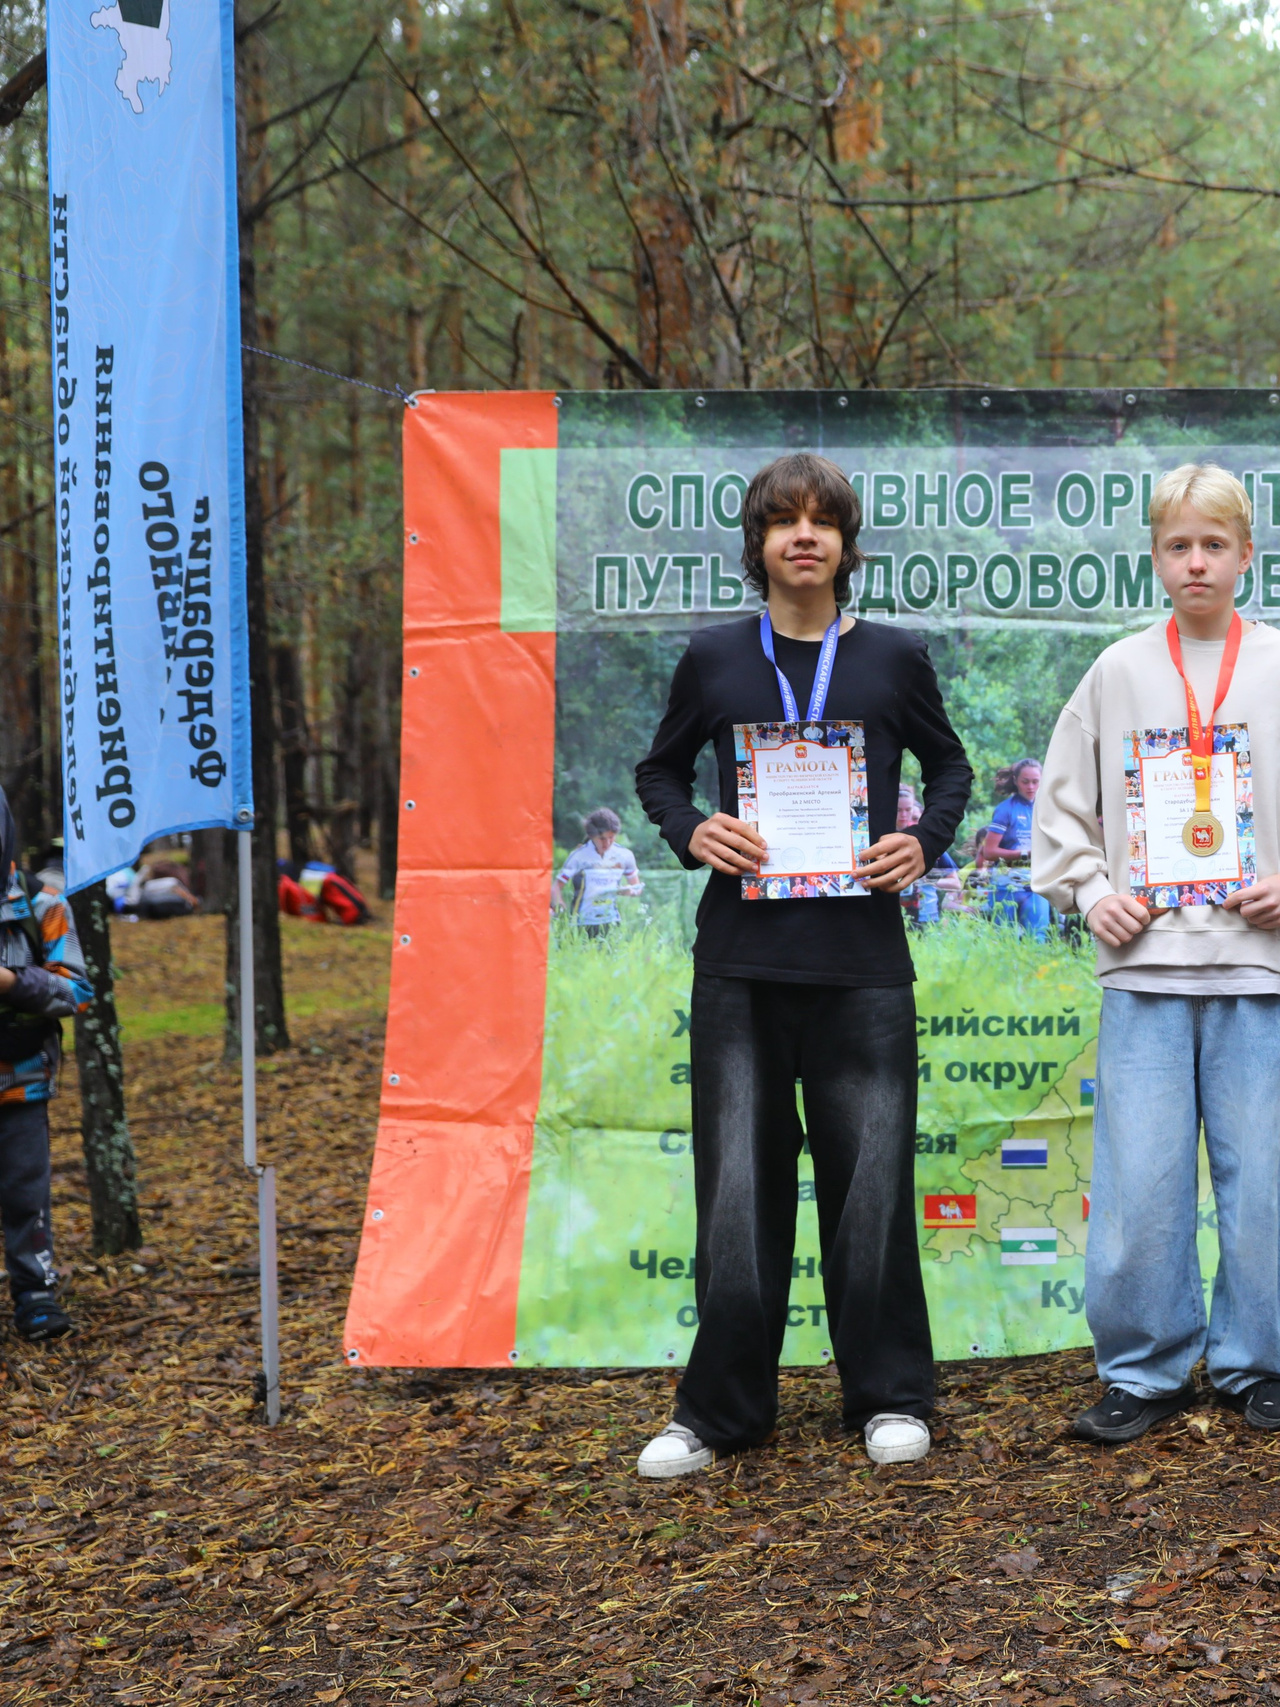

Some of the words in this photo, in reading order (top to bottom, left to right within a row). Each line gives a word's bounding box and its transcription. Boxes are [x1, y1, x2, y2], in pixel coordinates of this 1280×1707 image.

[594, 553, 746, 612] ПУТЬ
[819, 624, 837, 683] ЧЕЛЯБИНСКАЯ
[766, 760, 838, 773] ГРАМОТА
[944, 1061, 1058, 1090] округ
